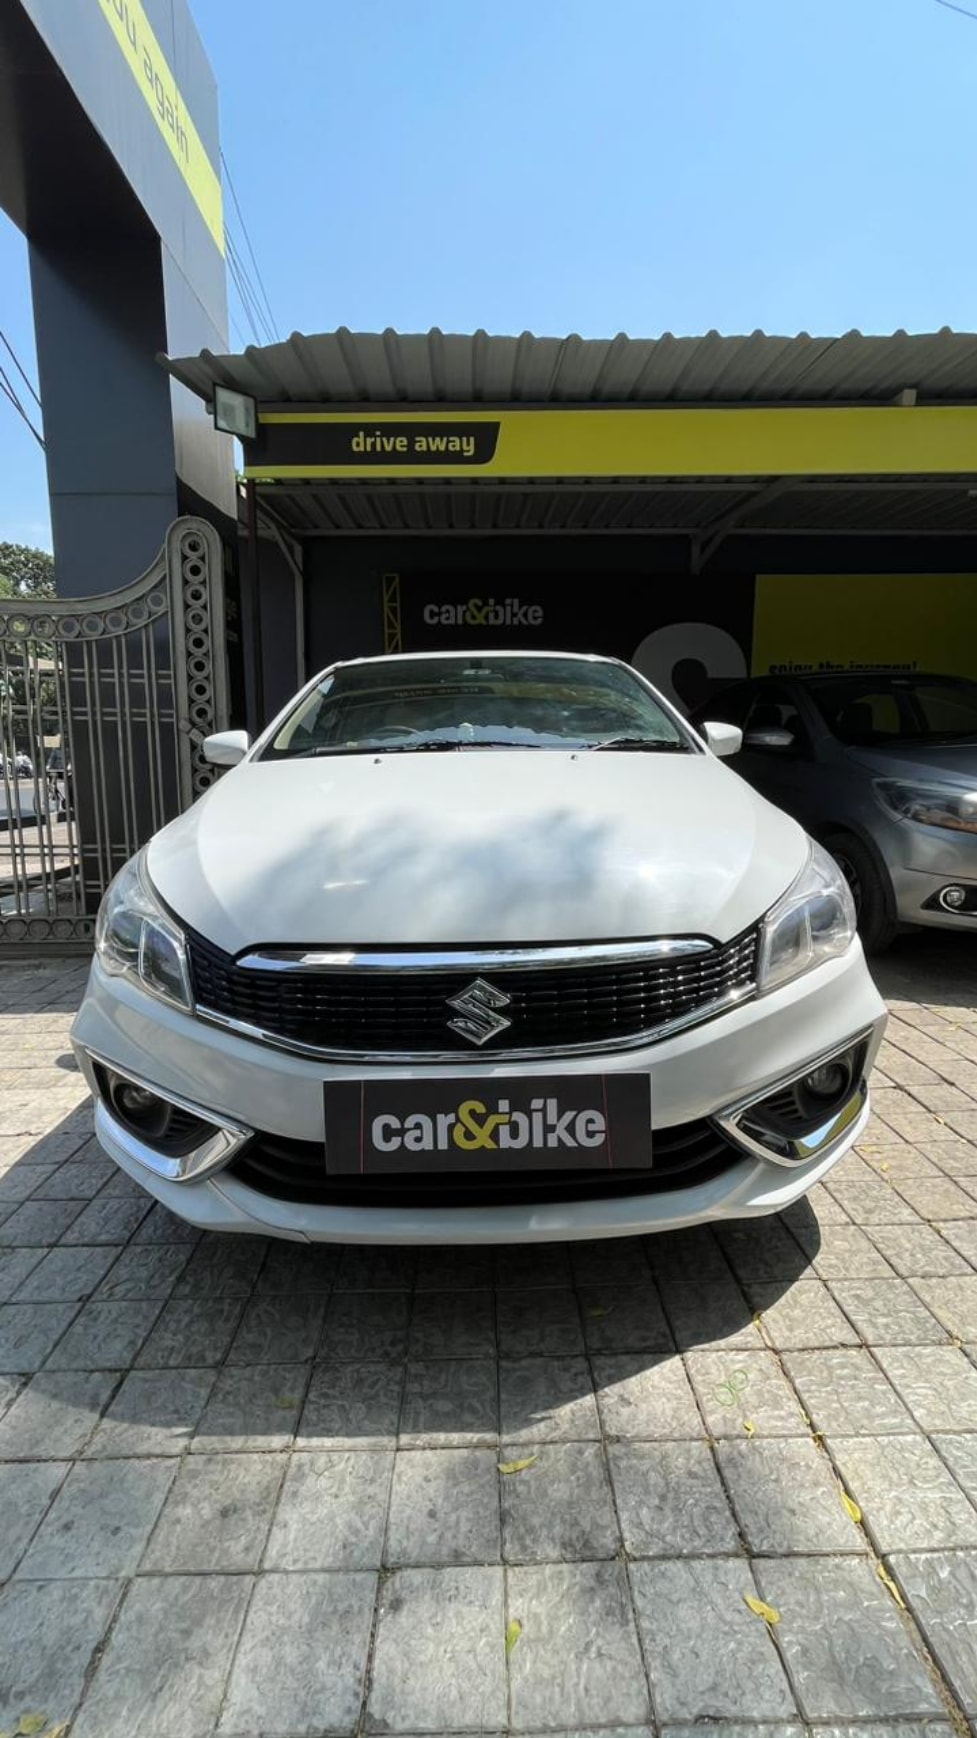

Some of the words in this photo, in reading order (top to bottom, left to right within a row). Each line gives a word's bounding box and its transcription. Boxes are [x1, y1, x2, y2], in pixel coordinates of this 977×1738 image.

[143, 44, 189, 163] again
[351, 431, 408, 452] drive
[414, 436, 475, 456] away
[423, 598, 544, 625] car&bike
[371, 1098, 606, 1152] car&bike
